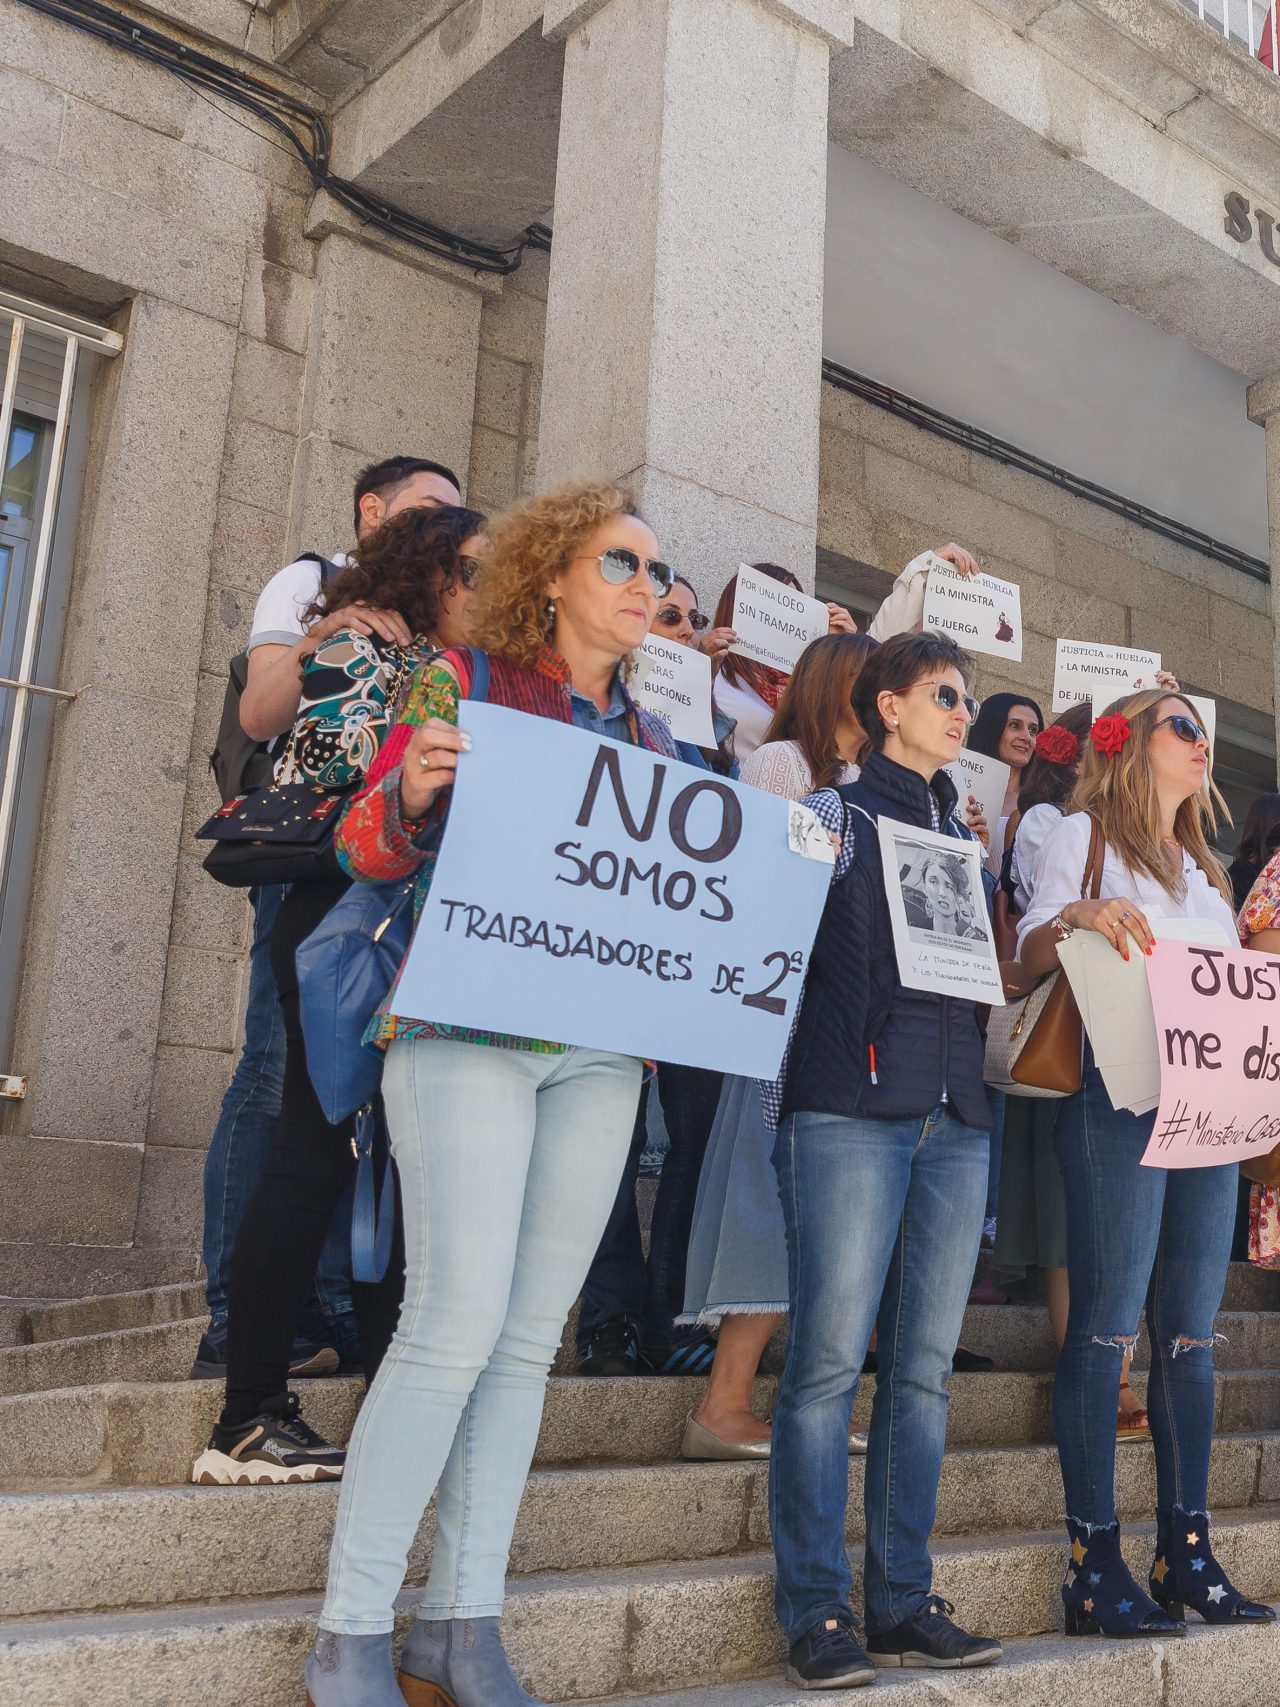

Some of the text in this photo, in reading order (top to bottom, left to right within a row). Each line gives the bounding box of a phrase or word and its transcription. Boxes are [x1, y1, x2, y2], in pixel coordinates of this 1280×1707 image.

[742, 578, 805, 614] POR UNA LOEO
[935, 584, 946, 596] LA
[948, 589, 994, 608] MINISTRA
[982, 579, 1014, 598] HUELGA
[739, 602, 807, 642] SIN TRAMPAS
[928, 615, 978, 636] DE JUERGA
[1061, 646, 1104, 658] JUSTICIA
[1116, 652, 1154, 665] HUELGA
[1066, 663, 1078, 672] LA
[1080, 664, 1129, 677] MINISTRA
[1058, 690, 1092, 702] DE JUE
[575, 744, 743, 863] NO
[554, 841, 735, 922] SOMOS
[440, 899, 693, 982] TRABAJADORES
[710, 963, 744, 996] DE
[1165, 1028, 1222, 1070] me
